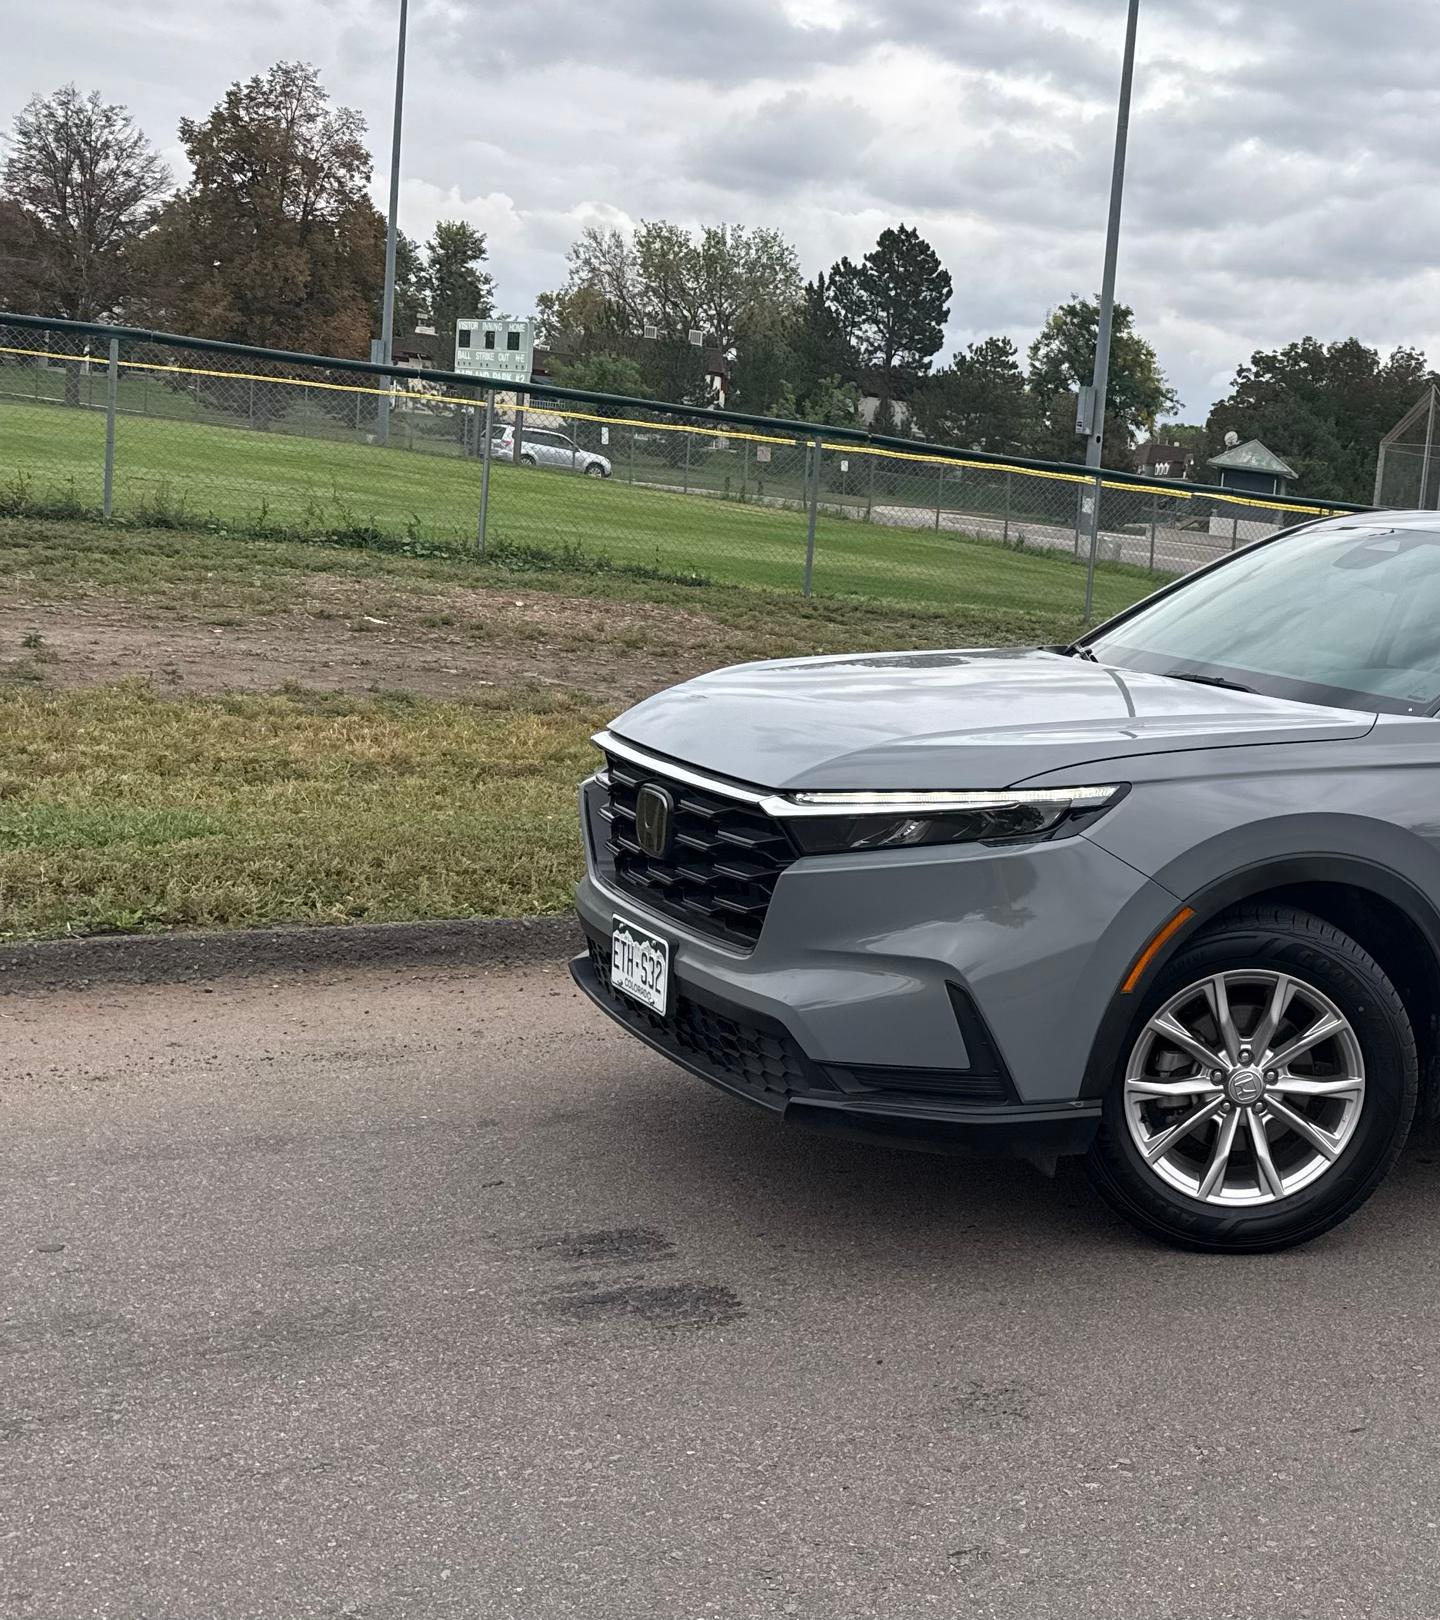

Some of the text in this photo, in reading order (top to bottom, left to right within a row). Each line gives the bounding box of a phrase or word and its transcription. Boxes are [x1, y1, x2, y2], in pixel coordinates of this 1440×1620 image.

[458, 321, 526, 332] VISITOR INNING HOME
[457, 350, 471, 360] BALL
[475, 352, 495, 361] STRIKE
[498, 353, 510, 361] OUT
[624, 977, 652, 1003] COLORADO
